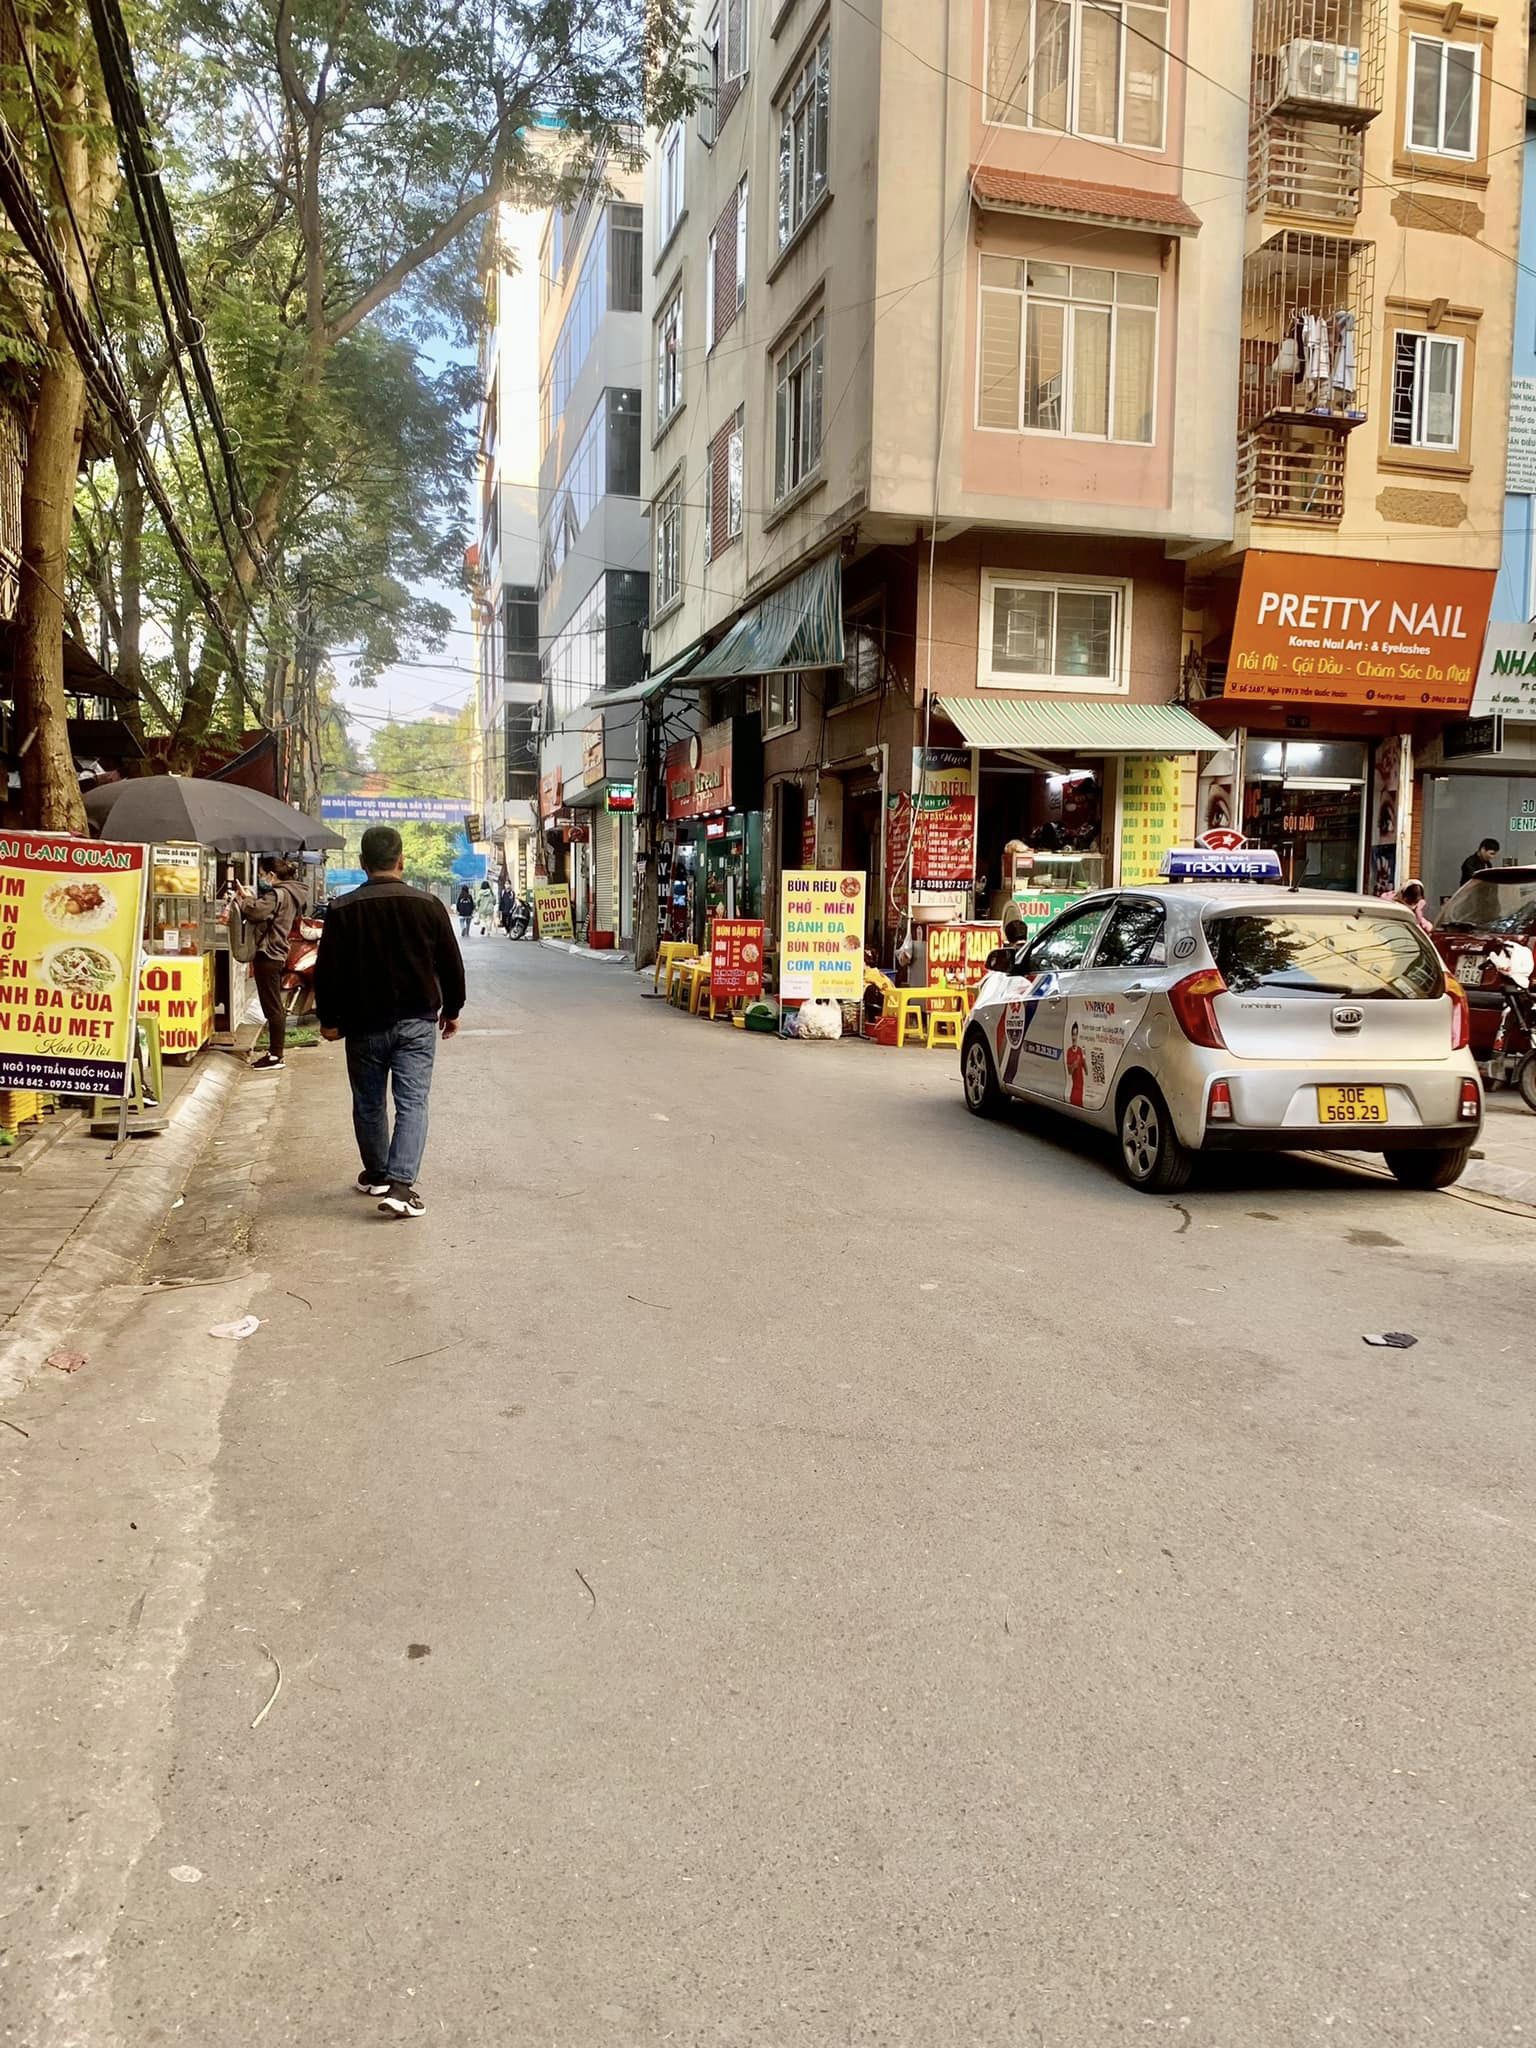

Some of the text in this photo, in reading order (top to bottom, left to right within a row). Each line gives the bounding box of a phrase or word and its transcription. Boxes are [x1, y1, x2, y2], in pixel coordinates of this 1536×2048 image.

[1257, 591, 1467, 638] PRETTY NAIL
[1289, 636, 1320, 648] Korea
[1322, 638, 1344, 649] Nail
[1345, 640, 1363, 651] Art
[1381, 642, 1431, 655] Eyelashes
[1261, 653, 1279, 671] Mi
[1399, 664, 1423, 680] Sóc
[1425, 665, 1443, 680] Da
[25, 843, 68, 862] LAN
[72, 847, 132, 869] QUÁN
[786, 877, 809, 893] BÚN
[537, 896, 568, 910] PHOTO
[542, 909, 567, 923] COPY
[731, 925, 746, 938] ĐẬU
[787, 918, 845, 933] BÁNH ĐA
[787, 938, 809, 953] BÚN
[929, 928, 960, 962] CƠM
[786, 960, 852, 972] CƠM RANG
[35, 988, 63, 1008] ĐA
[71, 991, 113, 1012] CUA
[17, 1011, 62, 1037] ĐẬU
[68, 1018, 115, 1042] MẸT
[26, 1063, 42, 1072] 199
[68, 1065, 95, 1078] QUỐC
[8, 1077, 24, 1086] 164
[26, 1078, 43, 1087] 842
[50, 1079, 72, 1089] 0975
[74, 1081, 91, 1091] 306
[92, 1082, 110, 1092] 274
[1338, 1088, 1366, 1103] 30E
[1327, 1105, 1380, 1120] 569.29
